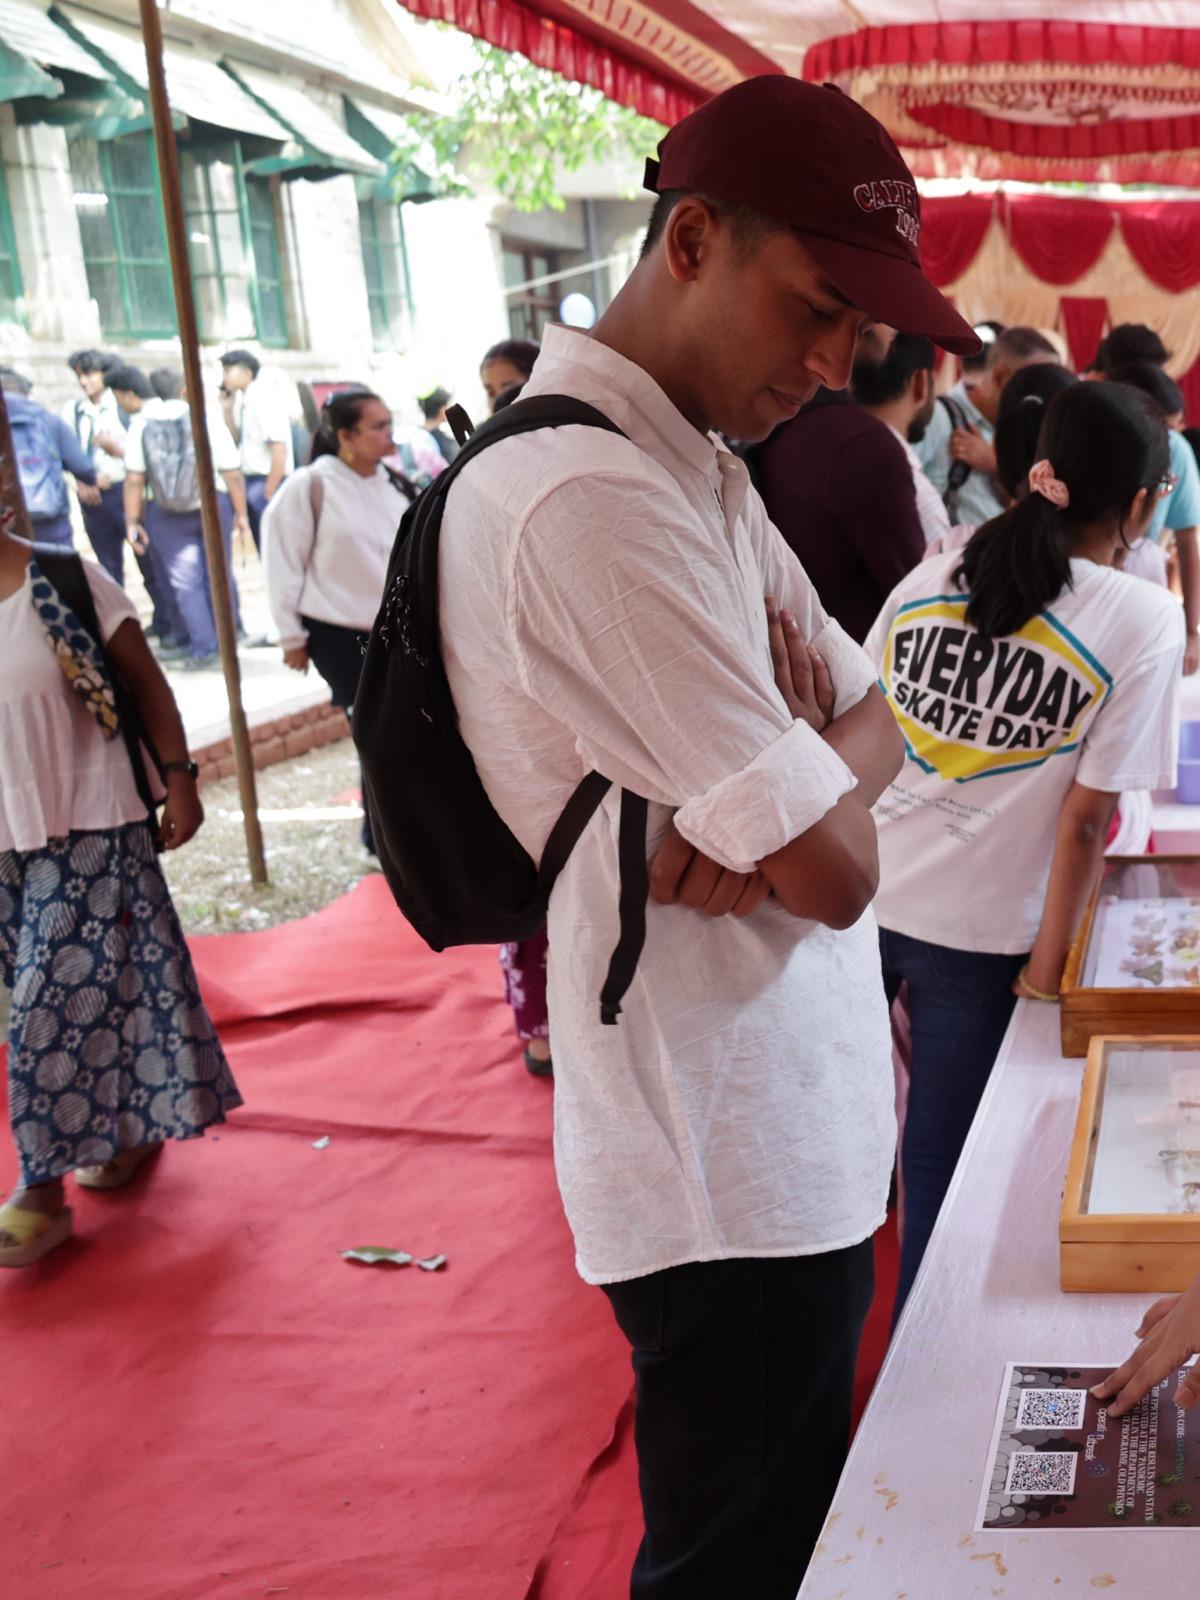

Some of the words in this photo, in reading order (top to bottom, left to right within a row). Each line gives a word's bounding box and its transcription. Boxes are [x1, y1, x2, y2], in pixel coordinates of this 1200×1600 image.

[893, 626, 1092, 729] EVERYDAY
[894, 683, 983, 741] SKATE
[986, 716, 1057, 750] DAY
[1130, 1435, 1138, 1449] THE
[1139, 1440, 1147, 1453] THE
[1148, 1436, 1156, 1449] THE
[1118, 1468, 1127, 1484] OLD
[1126, 1450, 1137, 1496] DEPARTMENT
[1147, 1450, 1155, 1479] RESULTS
[1146, 1480, 1154, 1496] AND
[1115, 1485, 1126, 1516] PHYSICS
[1145, 1497, 1154, 1520] STATS
